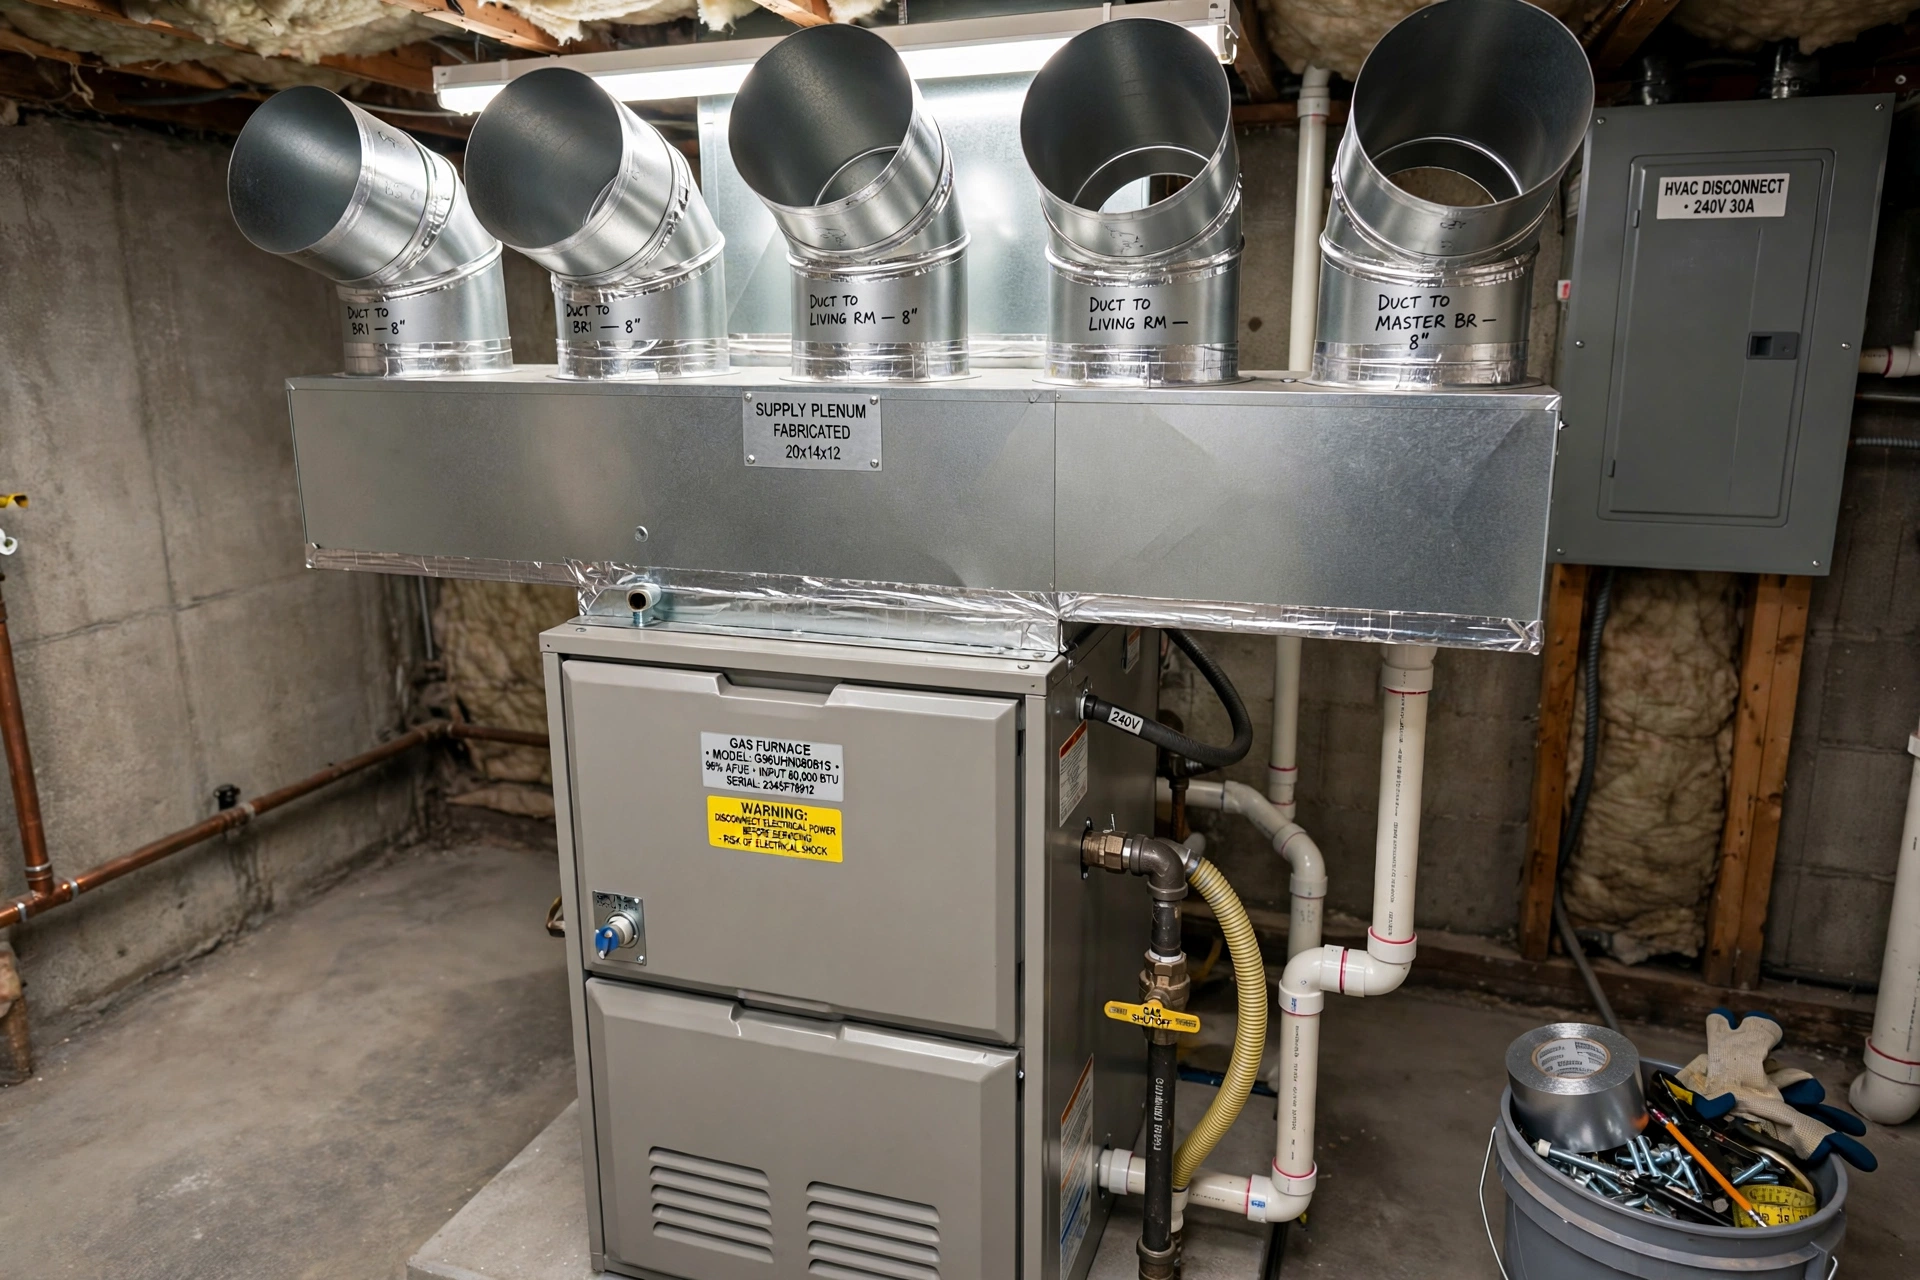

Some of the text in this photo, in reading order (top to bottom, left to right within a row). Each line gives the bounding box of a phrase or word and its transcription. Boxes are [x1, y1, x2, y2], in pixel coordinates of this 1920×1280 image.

[1665, 179, 1784, 196] HVAC DISCONNECT
[1694, 199, 1754, 214] 240V 30A
[810, 294, 858, 309] DUCT TO
[1090, 297, 1151, 312] DUCT TO
[1378, 294, 1450, 311] DUCT TO
[347, 306, 389, 319] DUCT TO
[567, 304, 609, 317] DUCT TO
[810, 312, 846, 326] LIVING
[854, 311, 876, 324] RM
[1089, 317, 1135, 331] LIVING
[1144, 316, 1166, 329] RM
[1375, 314, 1446, 331] MASTER
[1455, 313, 1477, 328] BR
[756, 402, 866, 419] SUPPLY PLENUM
[774, 423, 850, 439] FABRICATED
[786, 445, 840, 460] 20x14x12
[1111, 711, 1140, 729] 240V
[730, 738, 810, 756] GAS FURNACE
[713, 749, 752, 762] MODEL:
[726, 763, 749, 775] AFUE
[759, 767, 786, 779] INPUT
[820, 774, 838, 784] BTU
[727, 775, 760, 789] SERIAL:
[741, 802, 807, 821] WARNING:
[809, 824, 836, 836] POWER
